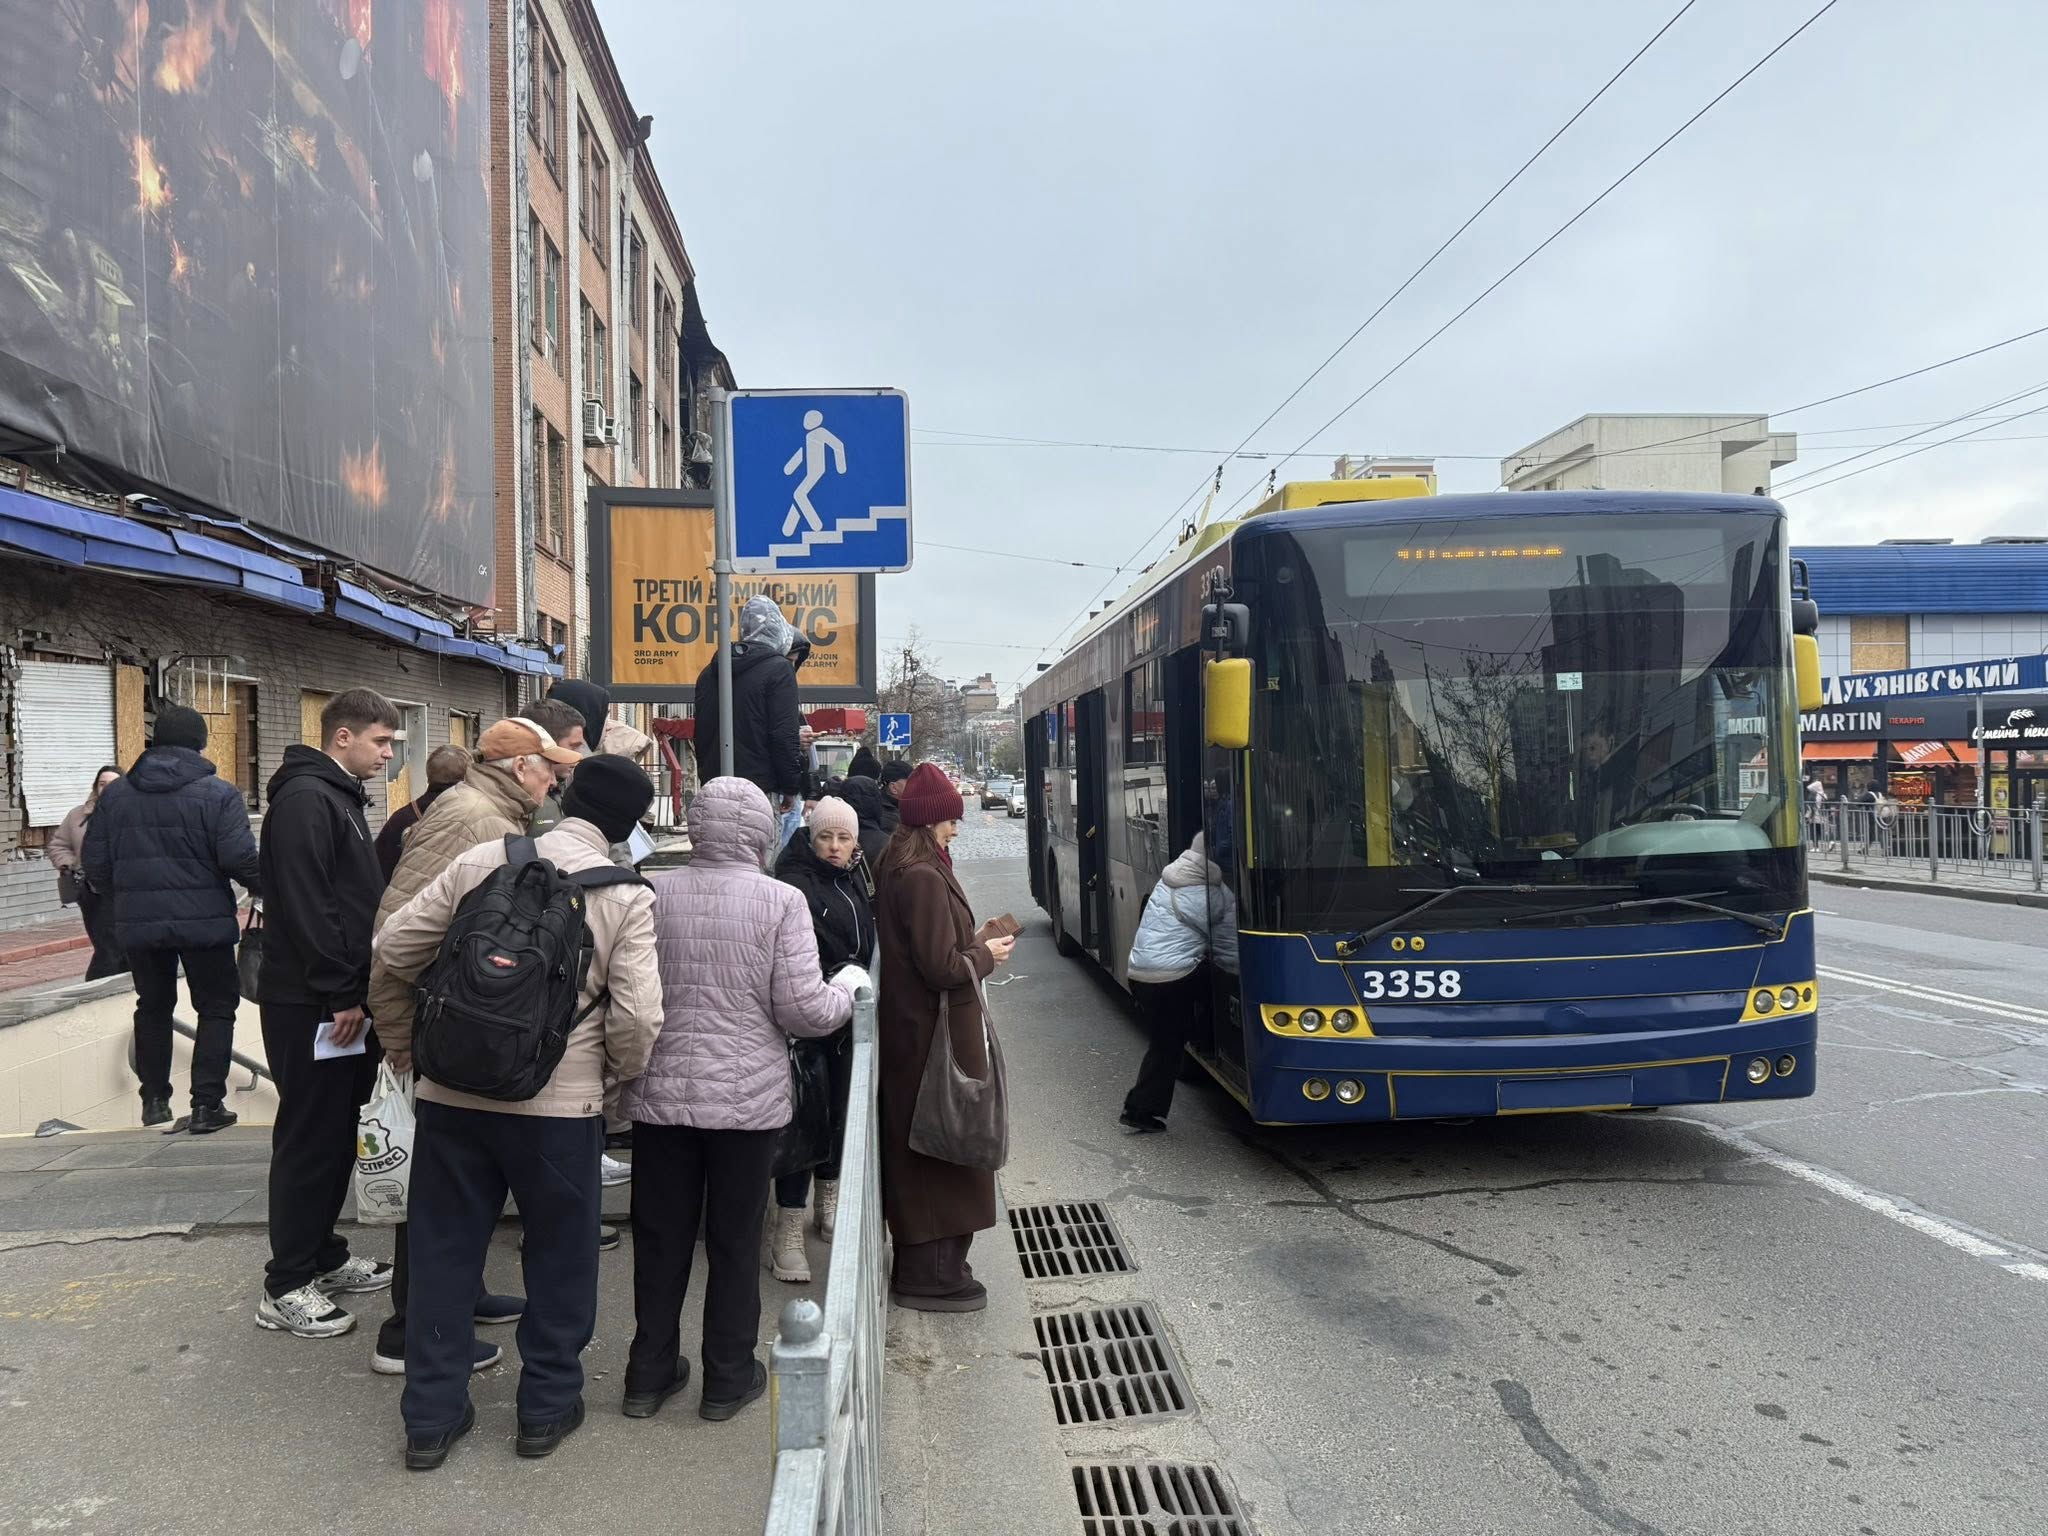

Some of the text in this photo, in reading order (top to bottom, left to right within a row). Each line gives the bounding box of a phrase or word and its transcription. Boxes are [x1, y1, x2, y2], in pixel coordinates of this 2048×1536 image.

[633, 575, 703, 604] ТРЕТІЙ
[633, 603, 838, 646] КОРС
[1800, 711, 1881, 732] MARTIN
[1971, 725, 2021, 740] Смейна
[1899, 741, 1944, 762] MARTIN
[1363, 970, 1462, 999] 3358
